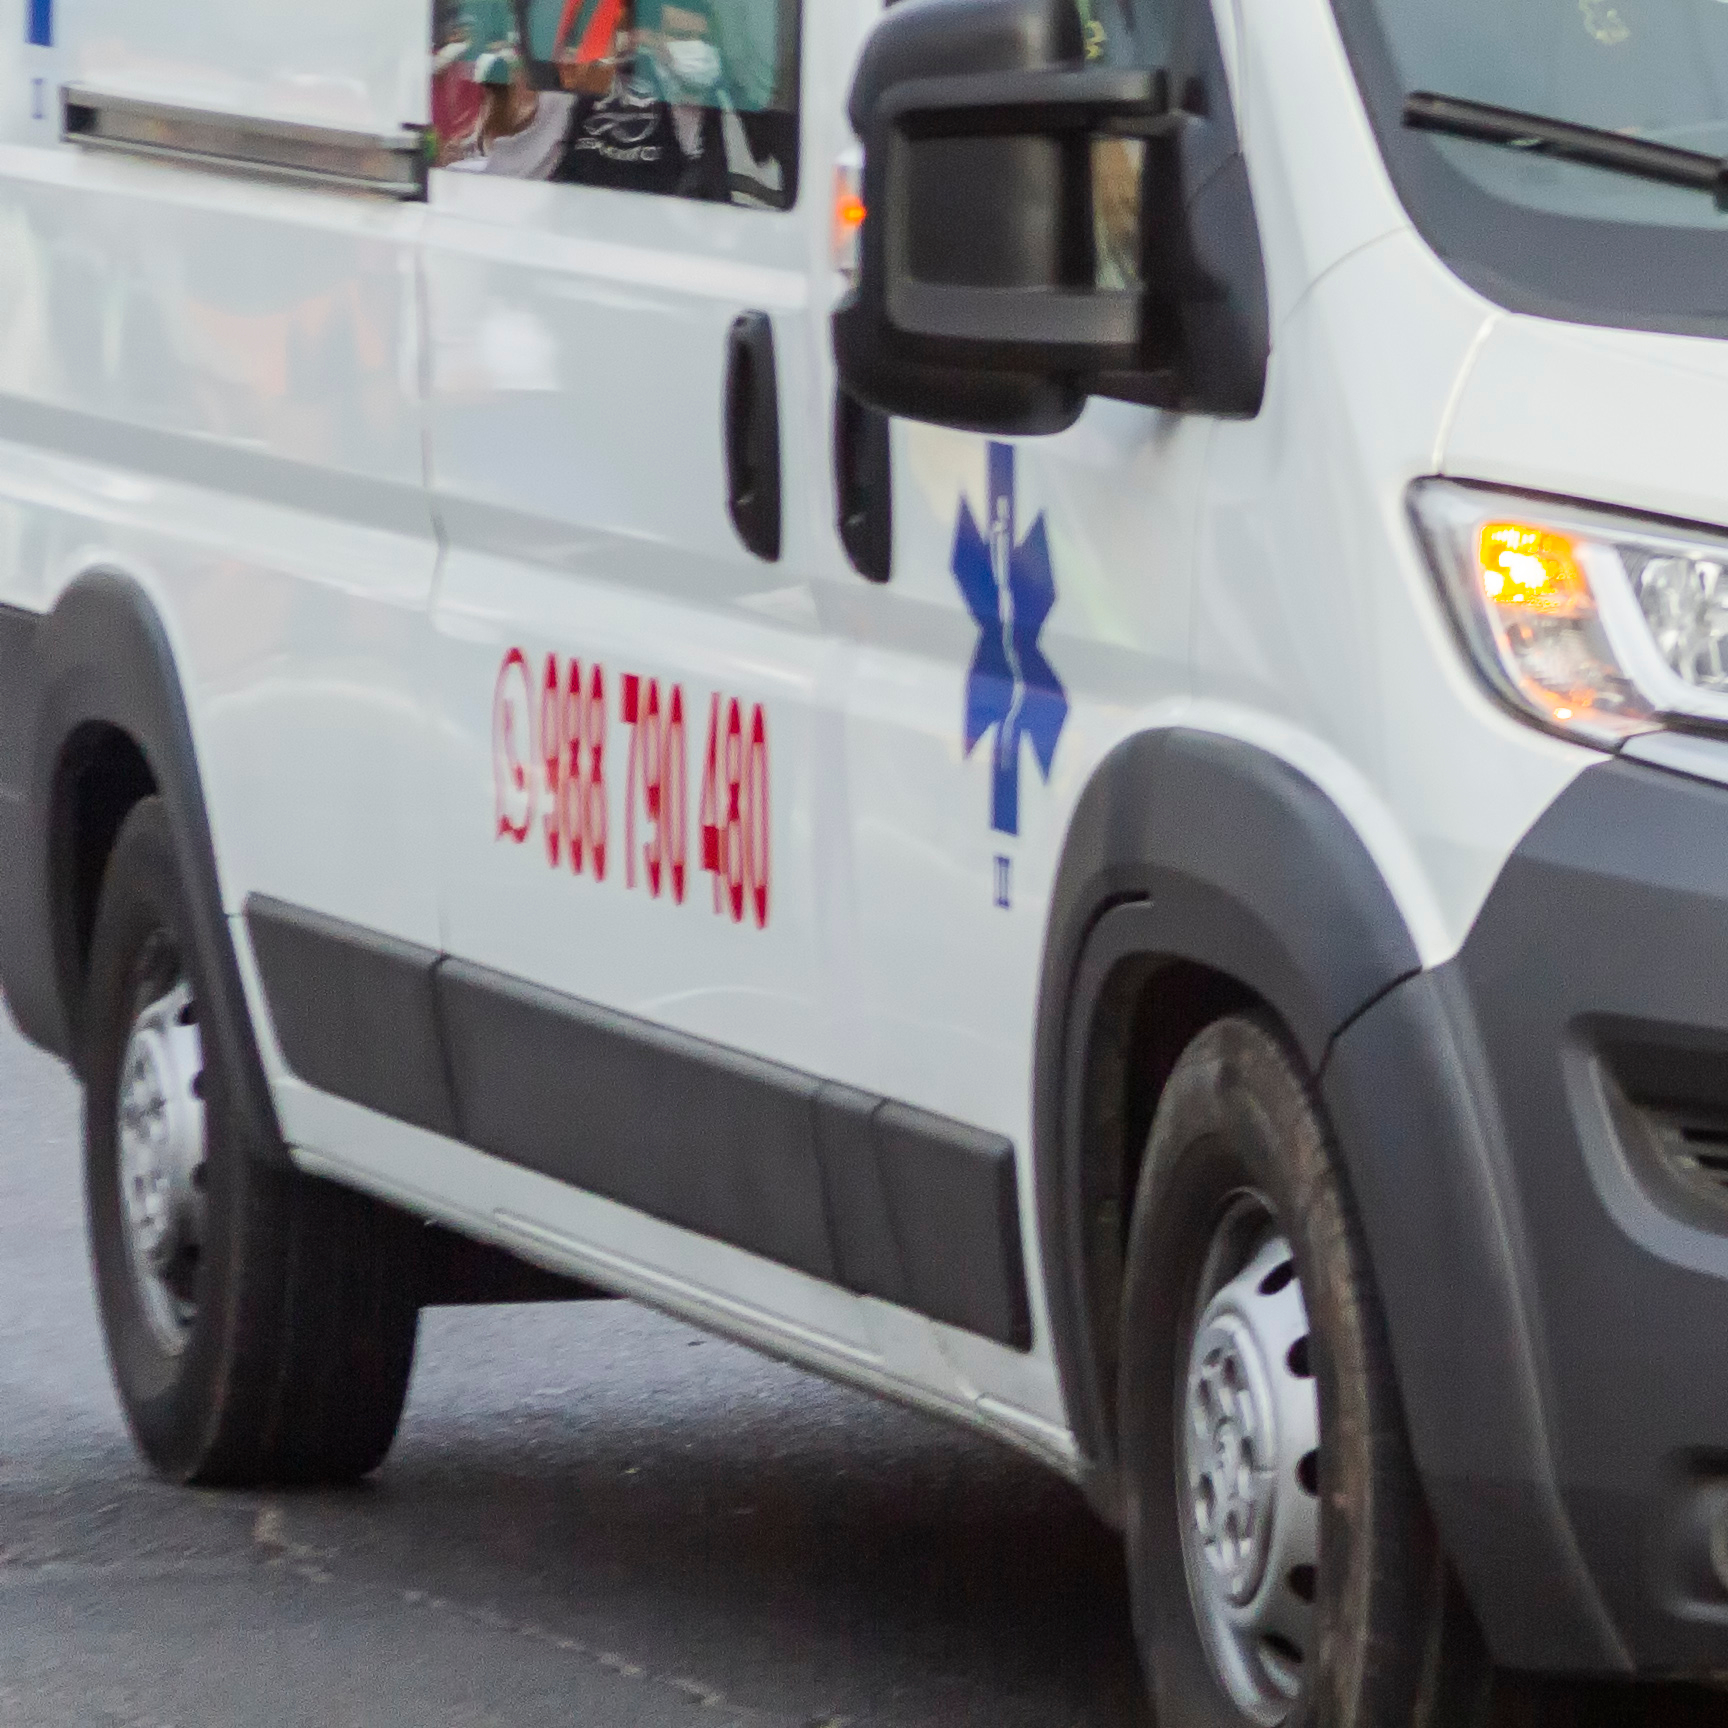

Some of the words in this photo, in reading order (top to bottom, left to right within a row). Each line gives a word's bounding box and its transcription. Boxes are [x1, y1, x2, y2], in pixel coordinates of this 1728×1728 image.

[541, 651, 609, 884] 988
[619, 672, 688, 906] 790
[699, 691, 771, 931] 480
